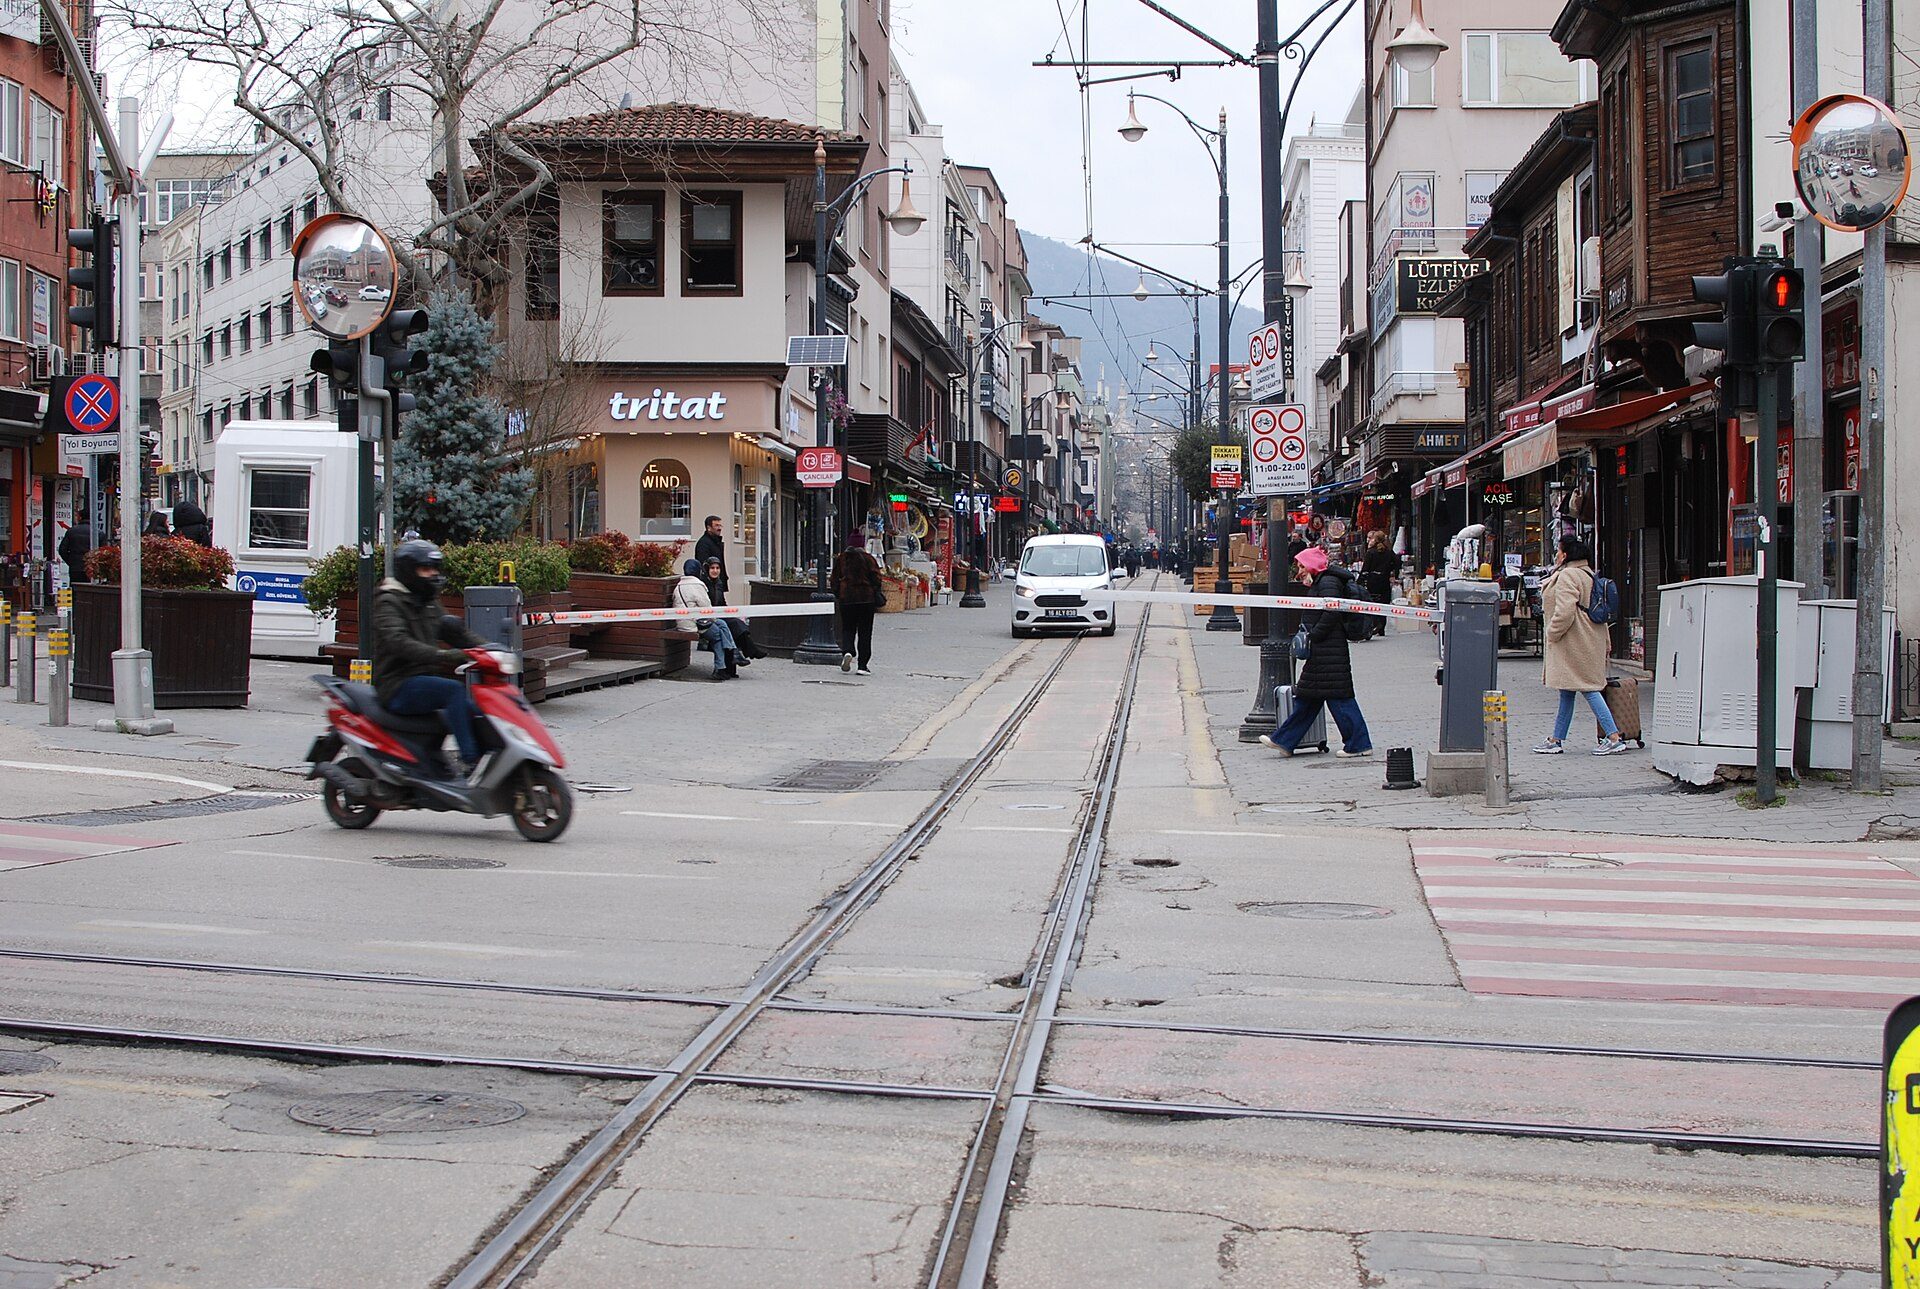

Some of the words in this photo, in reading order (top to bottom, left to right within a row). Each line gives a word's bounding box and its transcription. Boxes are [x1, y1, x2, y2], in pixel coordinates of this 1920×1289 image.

[1284, 295, 1292, 340] SEVİNÇ
[1284, 345, 1292, 374] MODA
[609, 388, 727, 420] tritat
[66, 440, 79, 448] Yol
[81, 439, 118, 449] Boyunca
[1418, 434, 1460, 447] AHMET
[804, 456, 816, 466] T3
[1255, 463, 1306, 473] 11:00-22:00
[642, 475, 680, 489] WIND
[803, 473, 834, 481] ÇANCILAR
[1483, 493, 1513, 505] KAŞE
